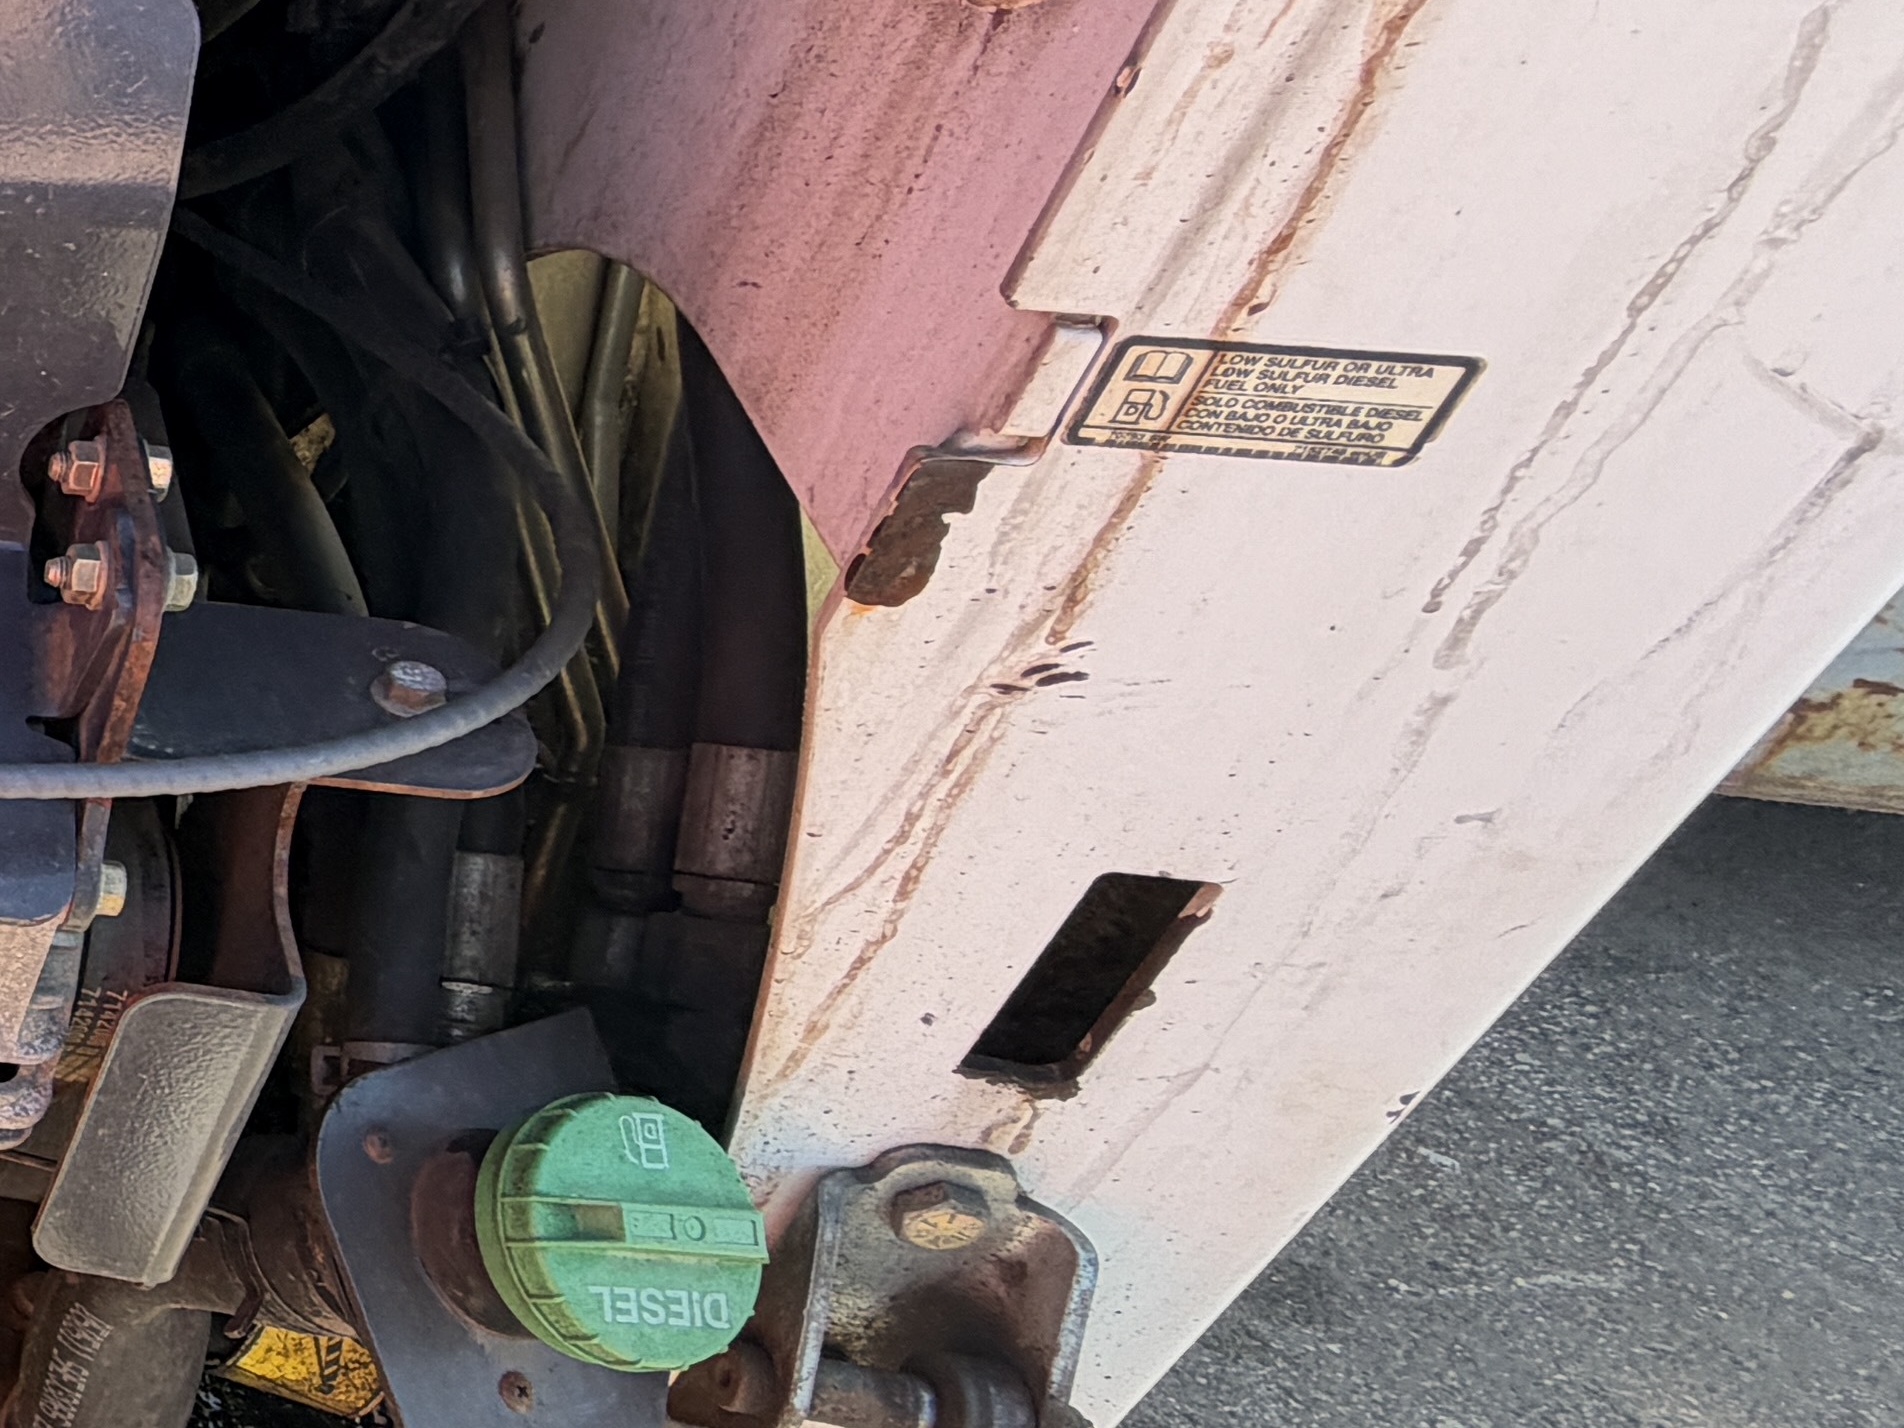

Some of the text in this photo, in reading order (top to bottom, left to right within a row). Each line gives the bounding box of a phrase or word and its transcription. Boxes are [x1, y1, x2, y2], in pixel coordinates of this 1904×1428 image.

[1210, 365, 1399, 390] LOW SULFUR DIESEL
[1218, 353, 1434, 379] LOW SULFUR OR ULTRA
[1201, 377, 1306, 396] FUEL ONLY
[1184, 406, 1394, 433] CON BAJO O ULTRA BAJO
[1189, 394, 1424, 423] SOLO COMBUSTIBLE DIESEL
[1177, 418, 1275, 437] CONTENIDO
[1278, 425, 1302, 439] DE
[1303, 426, 1386, 444] SULFURO
[587, 1285, 732, 1330] DIESEL
